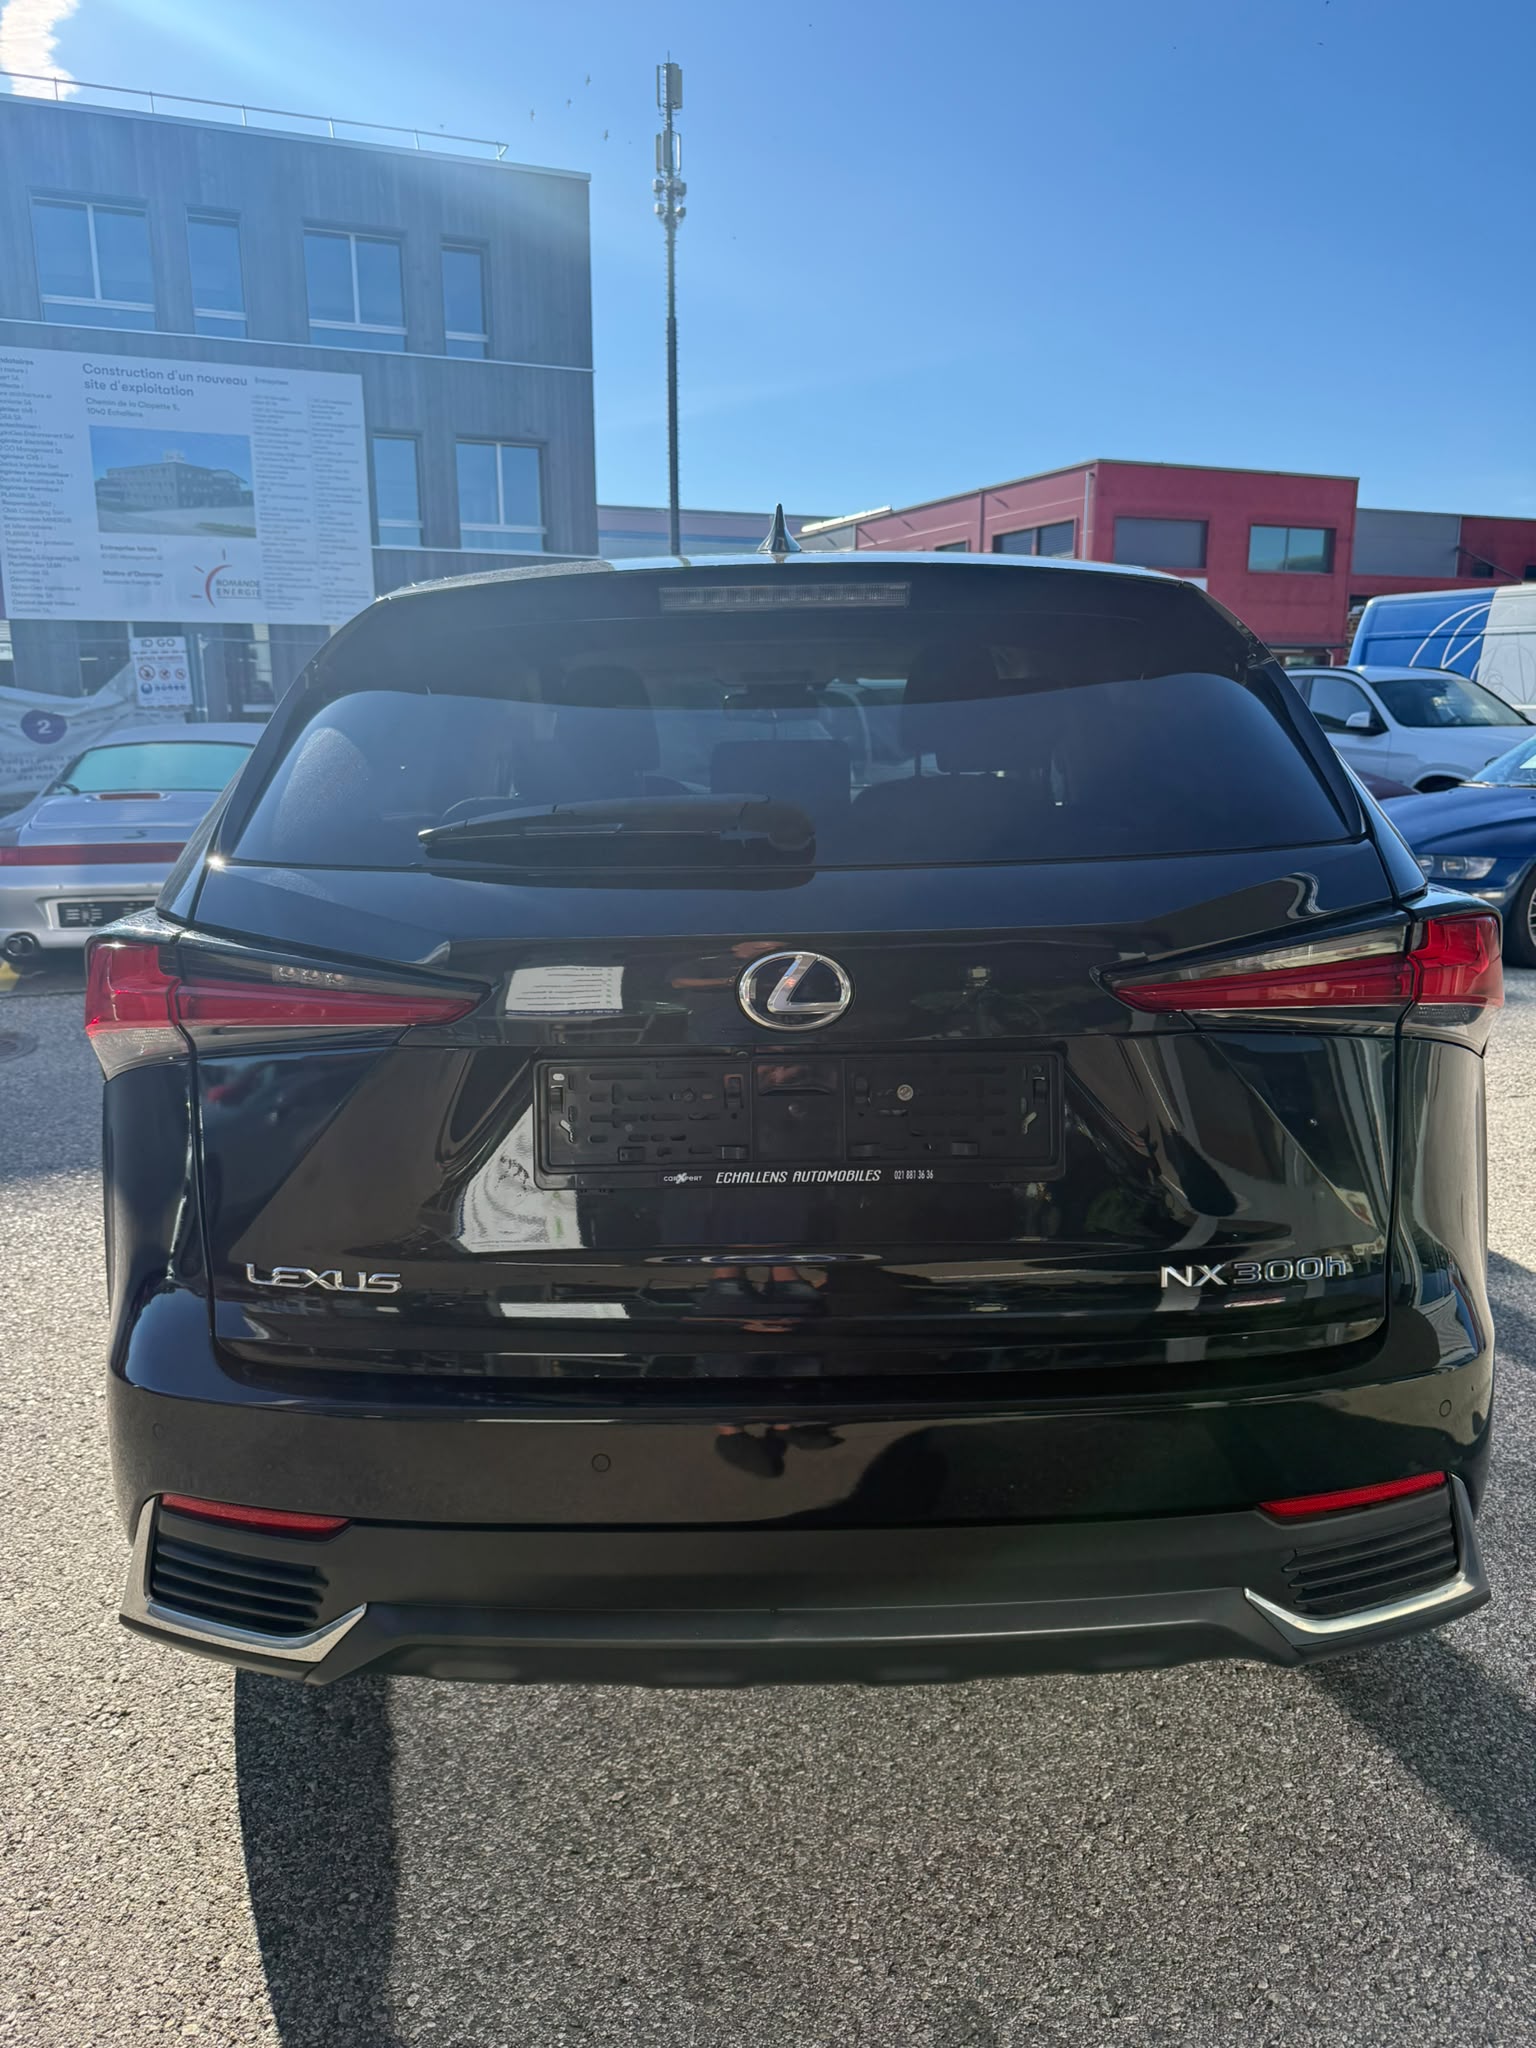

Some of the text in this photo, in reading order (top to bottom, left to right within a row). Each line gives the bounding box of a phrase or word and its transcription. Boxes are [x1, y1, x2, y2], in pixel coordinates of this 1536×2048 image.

[82, 363, 248, 387] Construction d'un nouveau
[84, 379, 194, 397] site d'exploitation
[86, 397, 116, 406] Chemin
[129, 400, 137, 408] la
[87, 407, 106, 415] 1040
[216, 579, 261, 587] ROMANDE
[216, 588, 262, 597] ENERGIE
[157, 638, 176, 647] GO
[37, 720, 52, 734] 2
[715, 1171, 788, 1184] ECHALLENS
[792, 1170, 881, 1183] AUTOMOBILES
[894, 1170, 905, 1180] 021
[906, 1170, 917, 1180] 881
[918, 1170, 925, 1180] 36
[926, 1169, 934, 1179] 36
[246, 1263, 402, 1293] LEXUS
[1161, 1256, 1347, 1288] NX 300h
